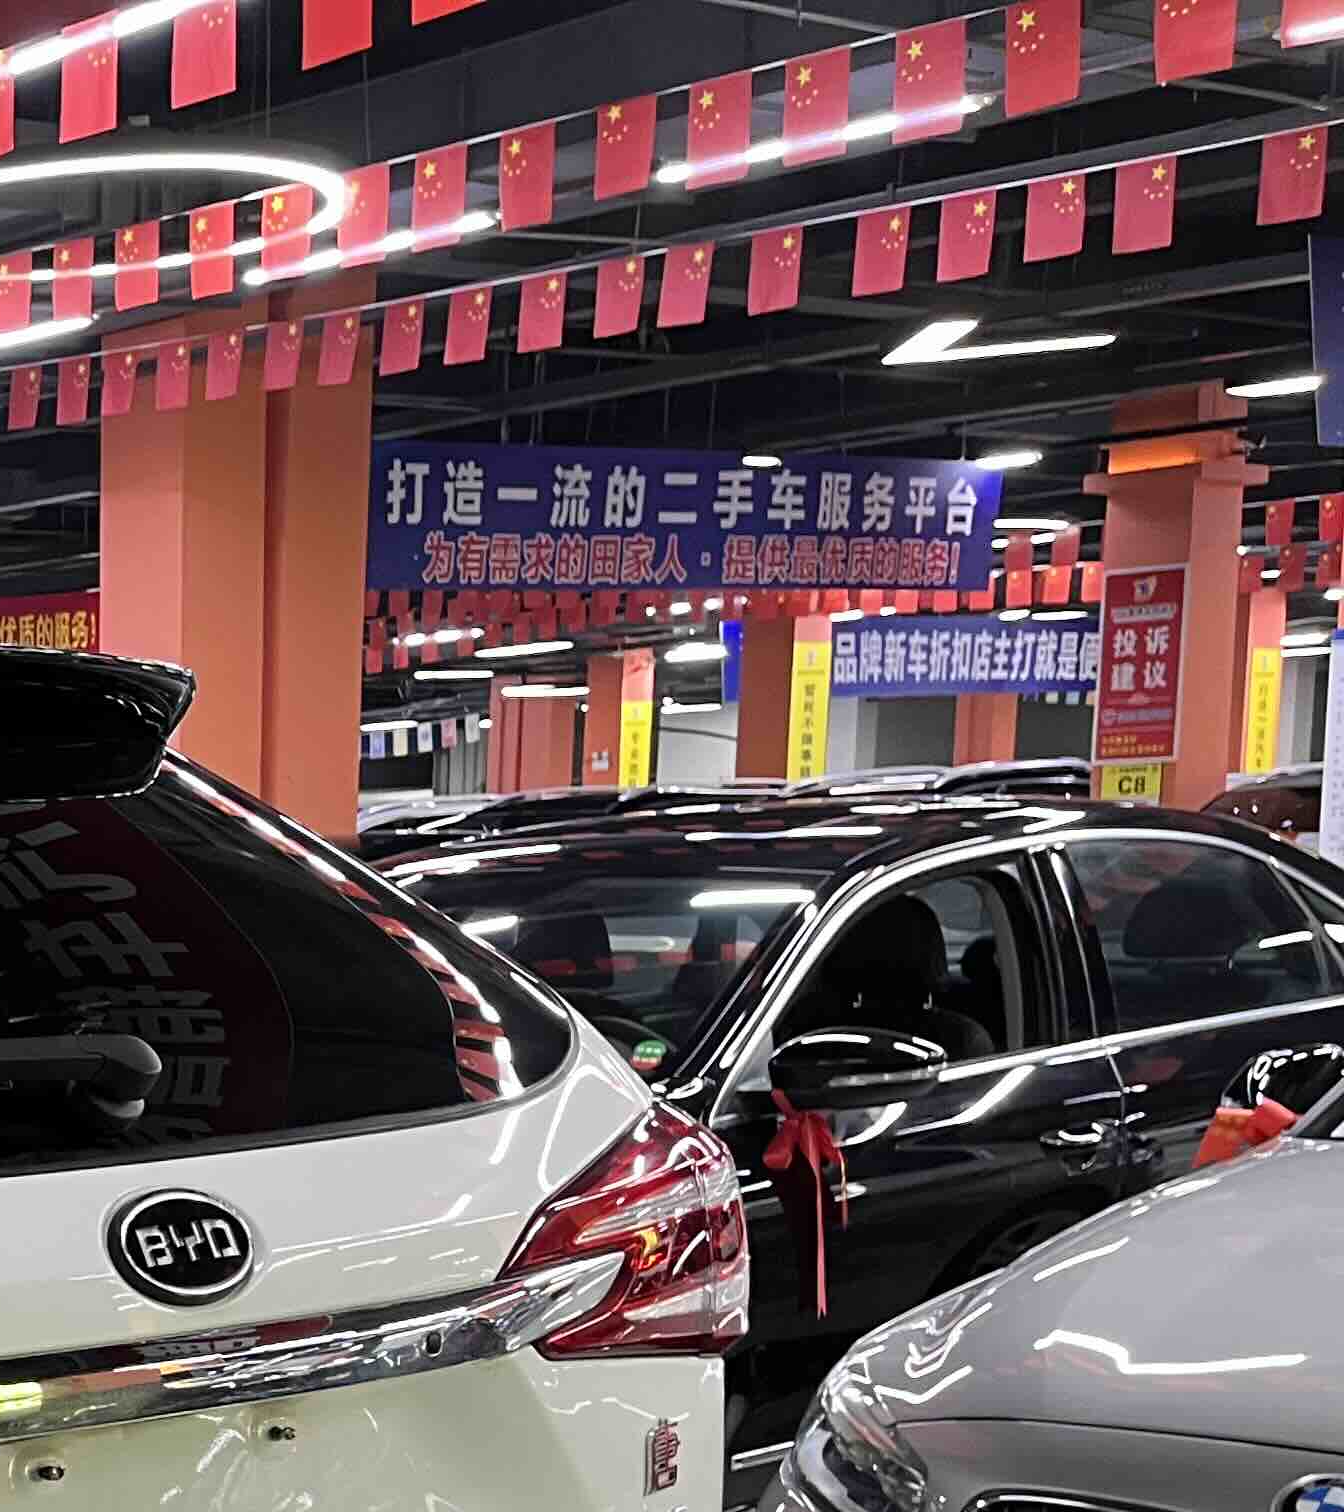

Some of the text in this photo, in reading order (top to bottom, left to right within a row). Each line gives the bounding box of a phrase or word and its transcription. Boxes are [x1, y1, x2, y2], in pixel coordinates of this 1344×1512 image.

[386, 458, 978, 537] 打造一流的二手车服务平台
[1112, 626, 1171, 660] 投诉
[1109, 660, 1169, 692] 建议
[1118, 775, 1146, 794] C8
[135, 1219, 242, 1269] BYD
